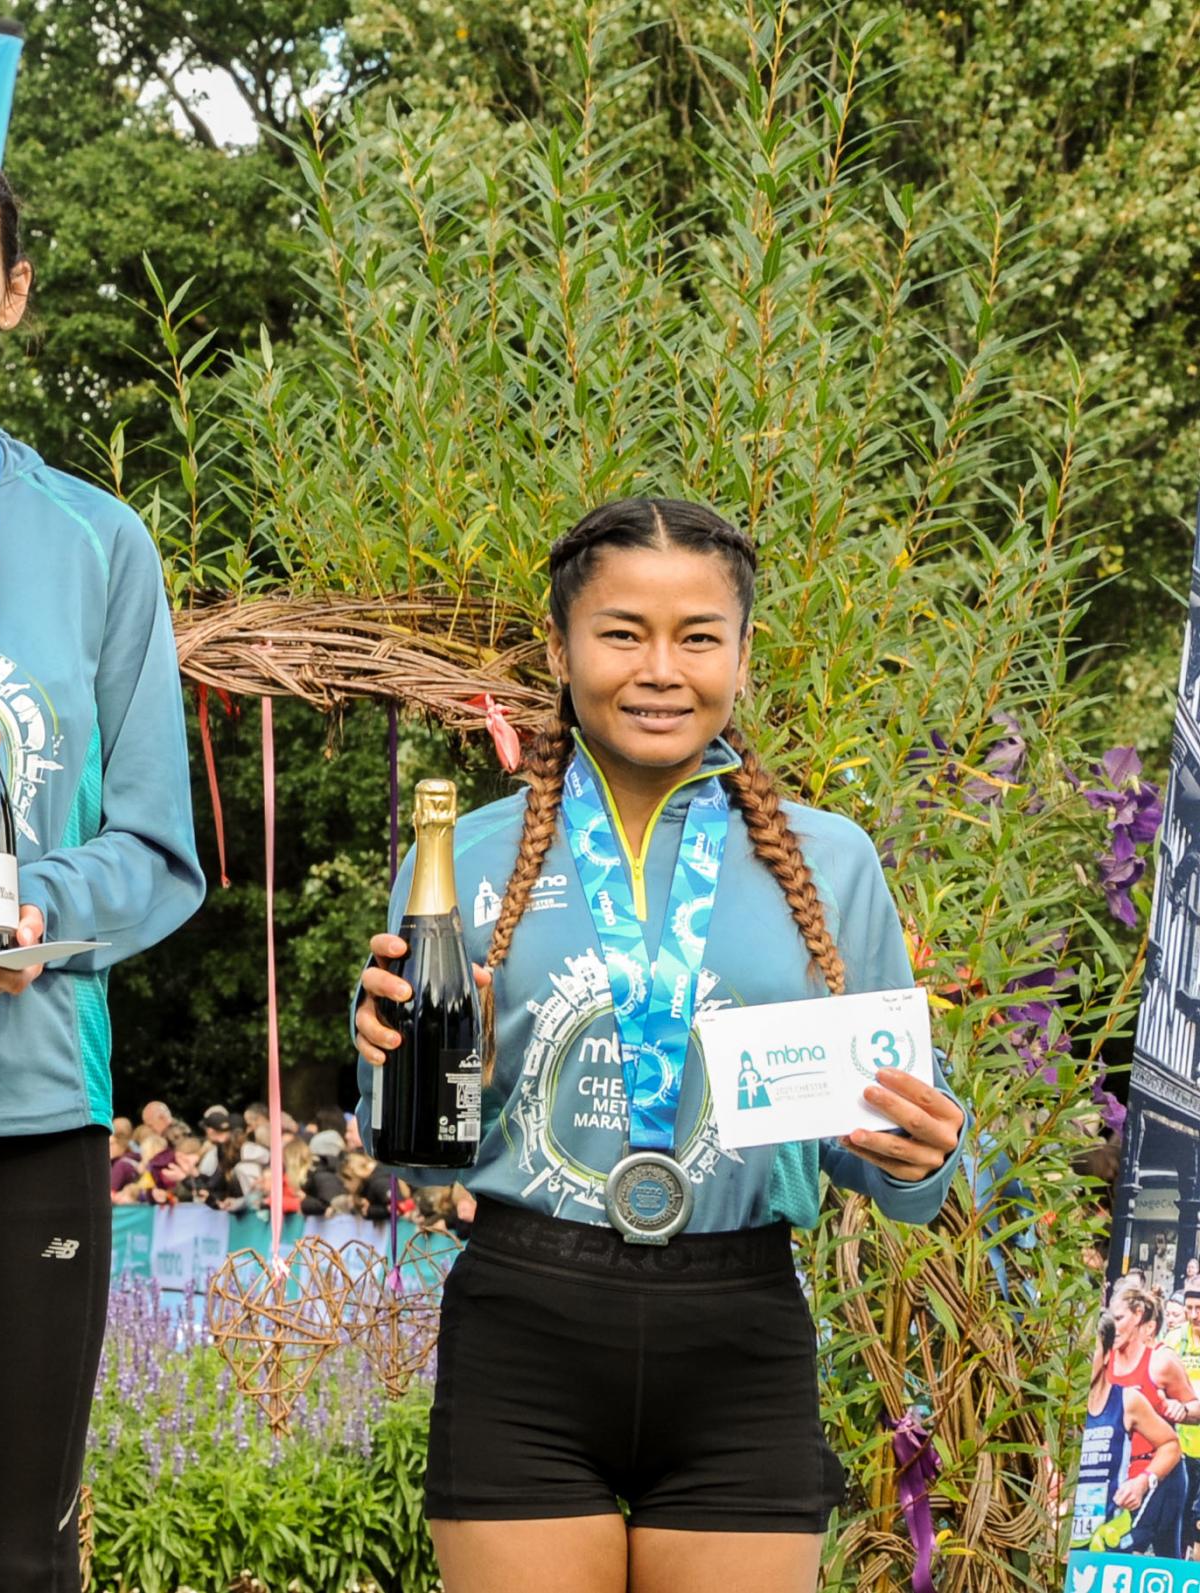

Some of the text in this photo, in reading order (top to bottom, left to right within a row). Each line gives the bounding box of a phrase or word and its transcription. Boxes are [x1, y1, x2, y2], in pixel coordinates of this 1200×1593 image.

[670, 974, 688, 1018] mbna
[766, 1045, 826, 1066] mbna
[871, 1030, 900, 1068] 3
[593, 1098, 628, 1114] MET
